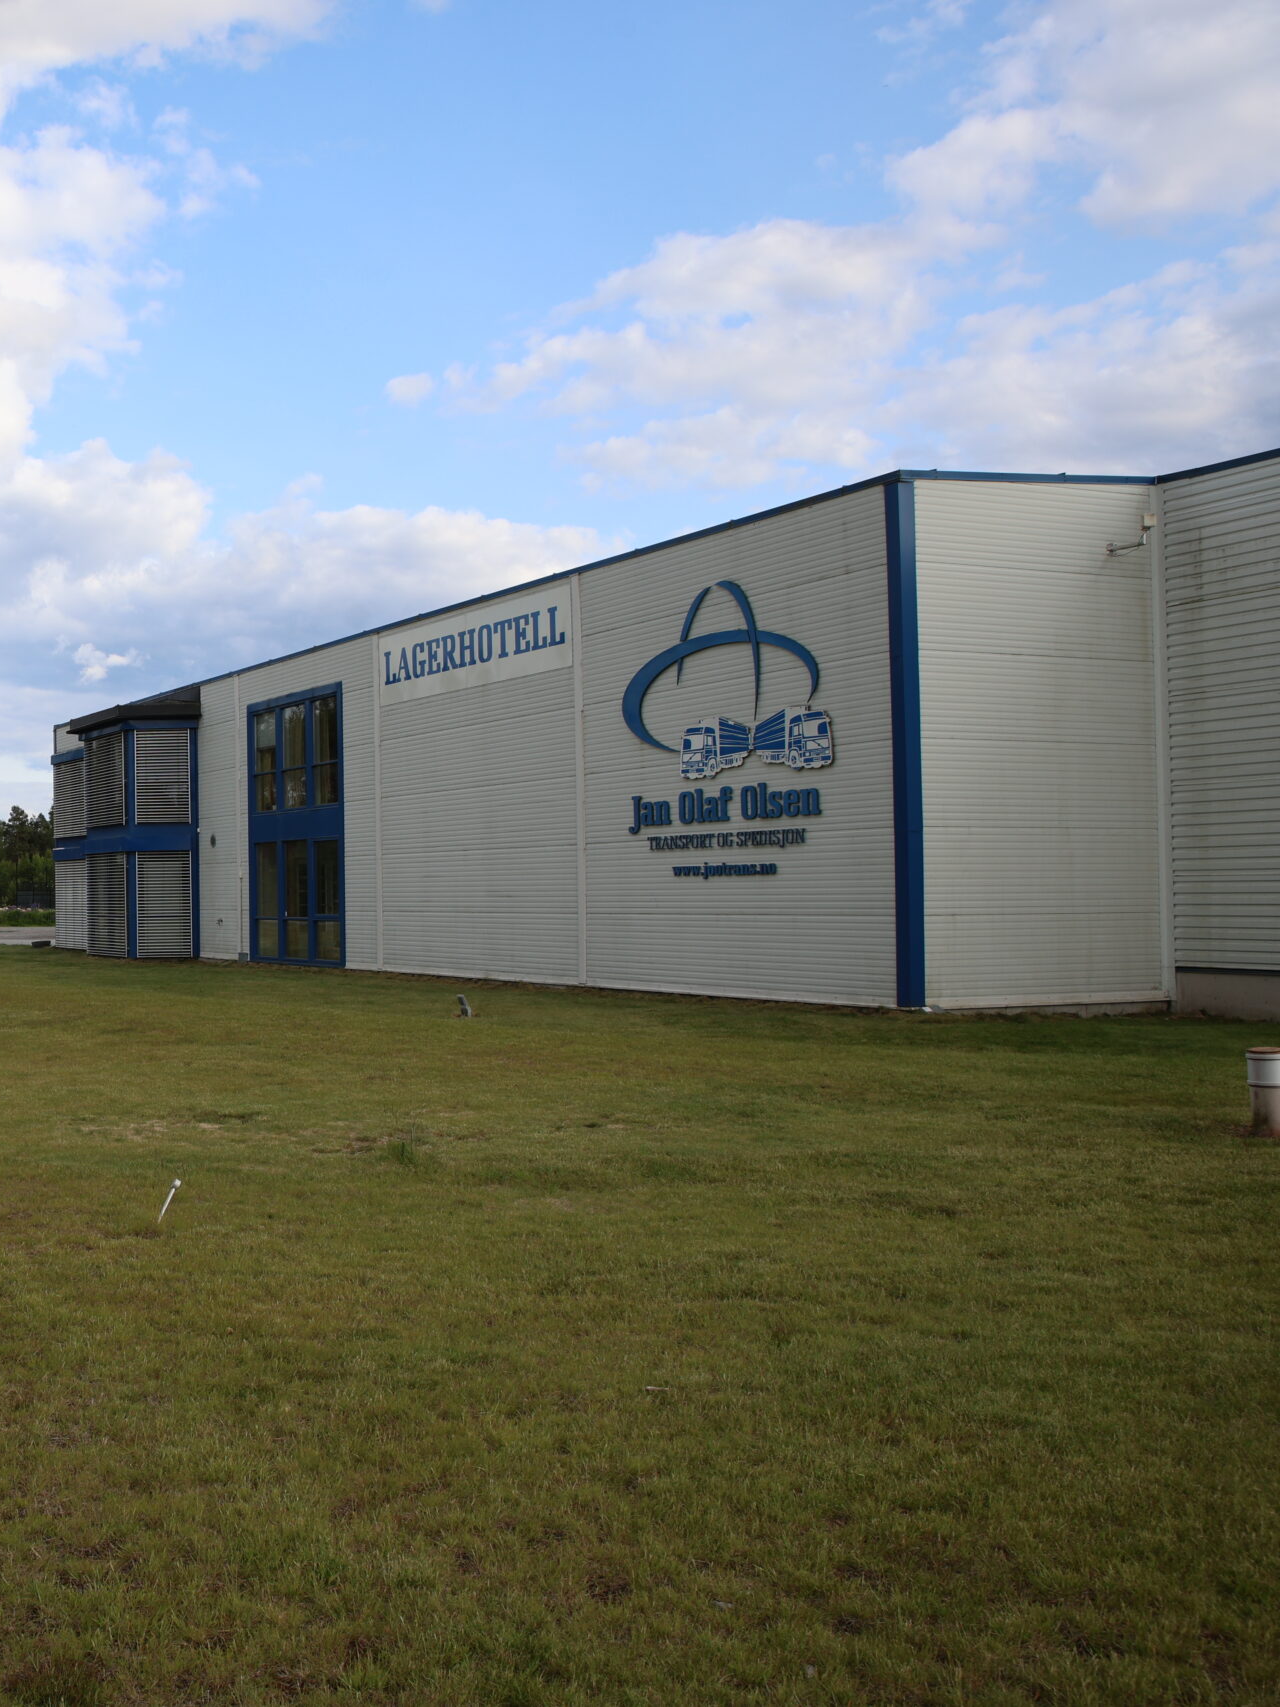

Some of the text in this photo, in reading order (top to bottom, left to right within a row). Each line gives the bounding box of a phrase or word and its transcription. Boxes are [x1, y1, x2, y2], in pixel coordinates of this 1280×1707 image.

[384, 606, 566, 685] LAGERHOTELL
[628, 782, 821, 834] Jan Olaf Olsen
[648, 828, 807, 850] TRANSPORT OG SPEDISJON
